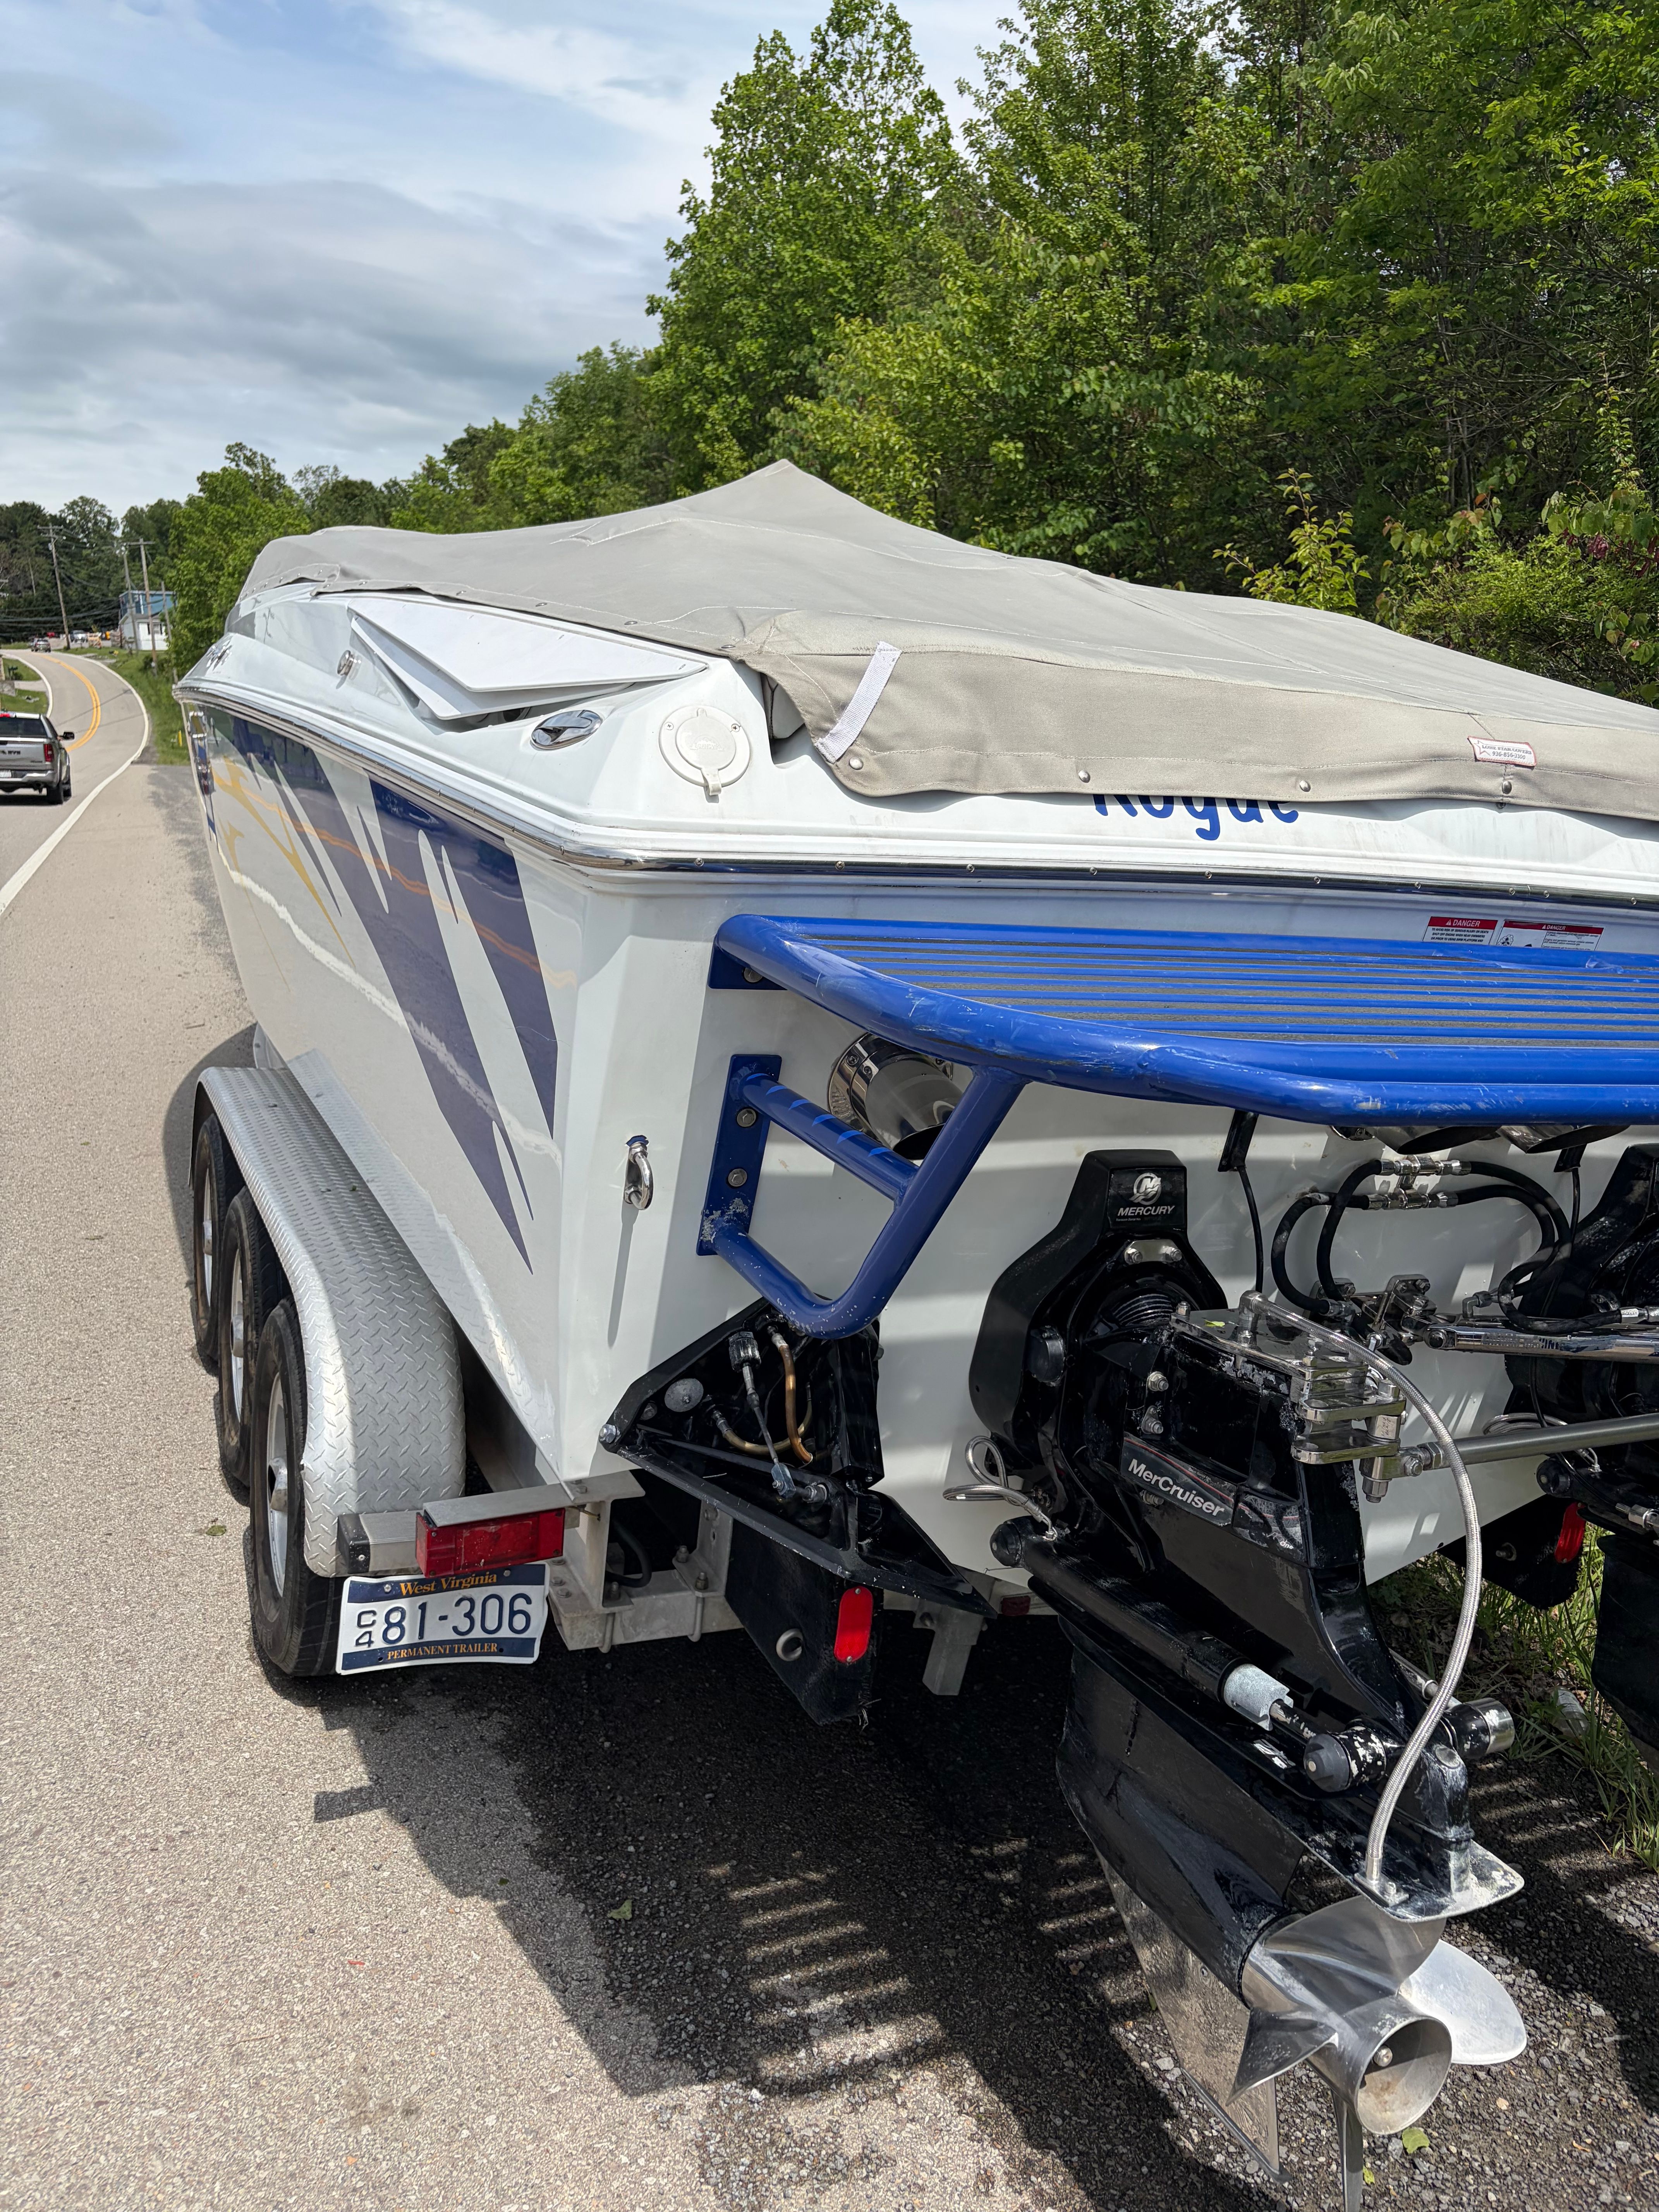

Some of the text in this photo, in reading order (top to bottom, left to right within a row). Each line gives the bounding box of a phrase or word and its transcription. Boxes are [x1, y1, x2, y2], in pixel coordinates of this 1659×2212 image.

[1452, 919, 1480, 927] DANGER
[1118, 1205, 1175, 1216] MERCURY
[1128, 1458, 1224, 1517] MerCruiser
[400, 1571, 497, 1596] West Virginia
[382, 1593, 532, 1645] 81-306
[387, 1642, 498, 1661] PERMANENT TRAILER
